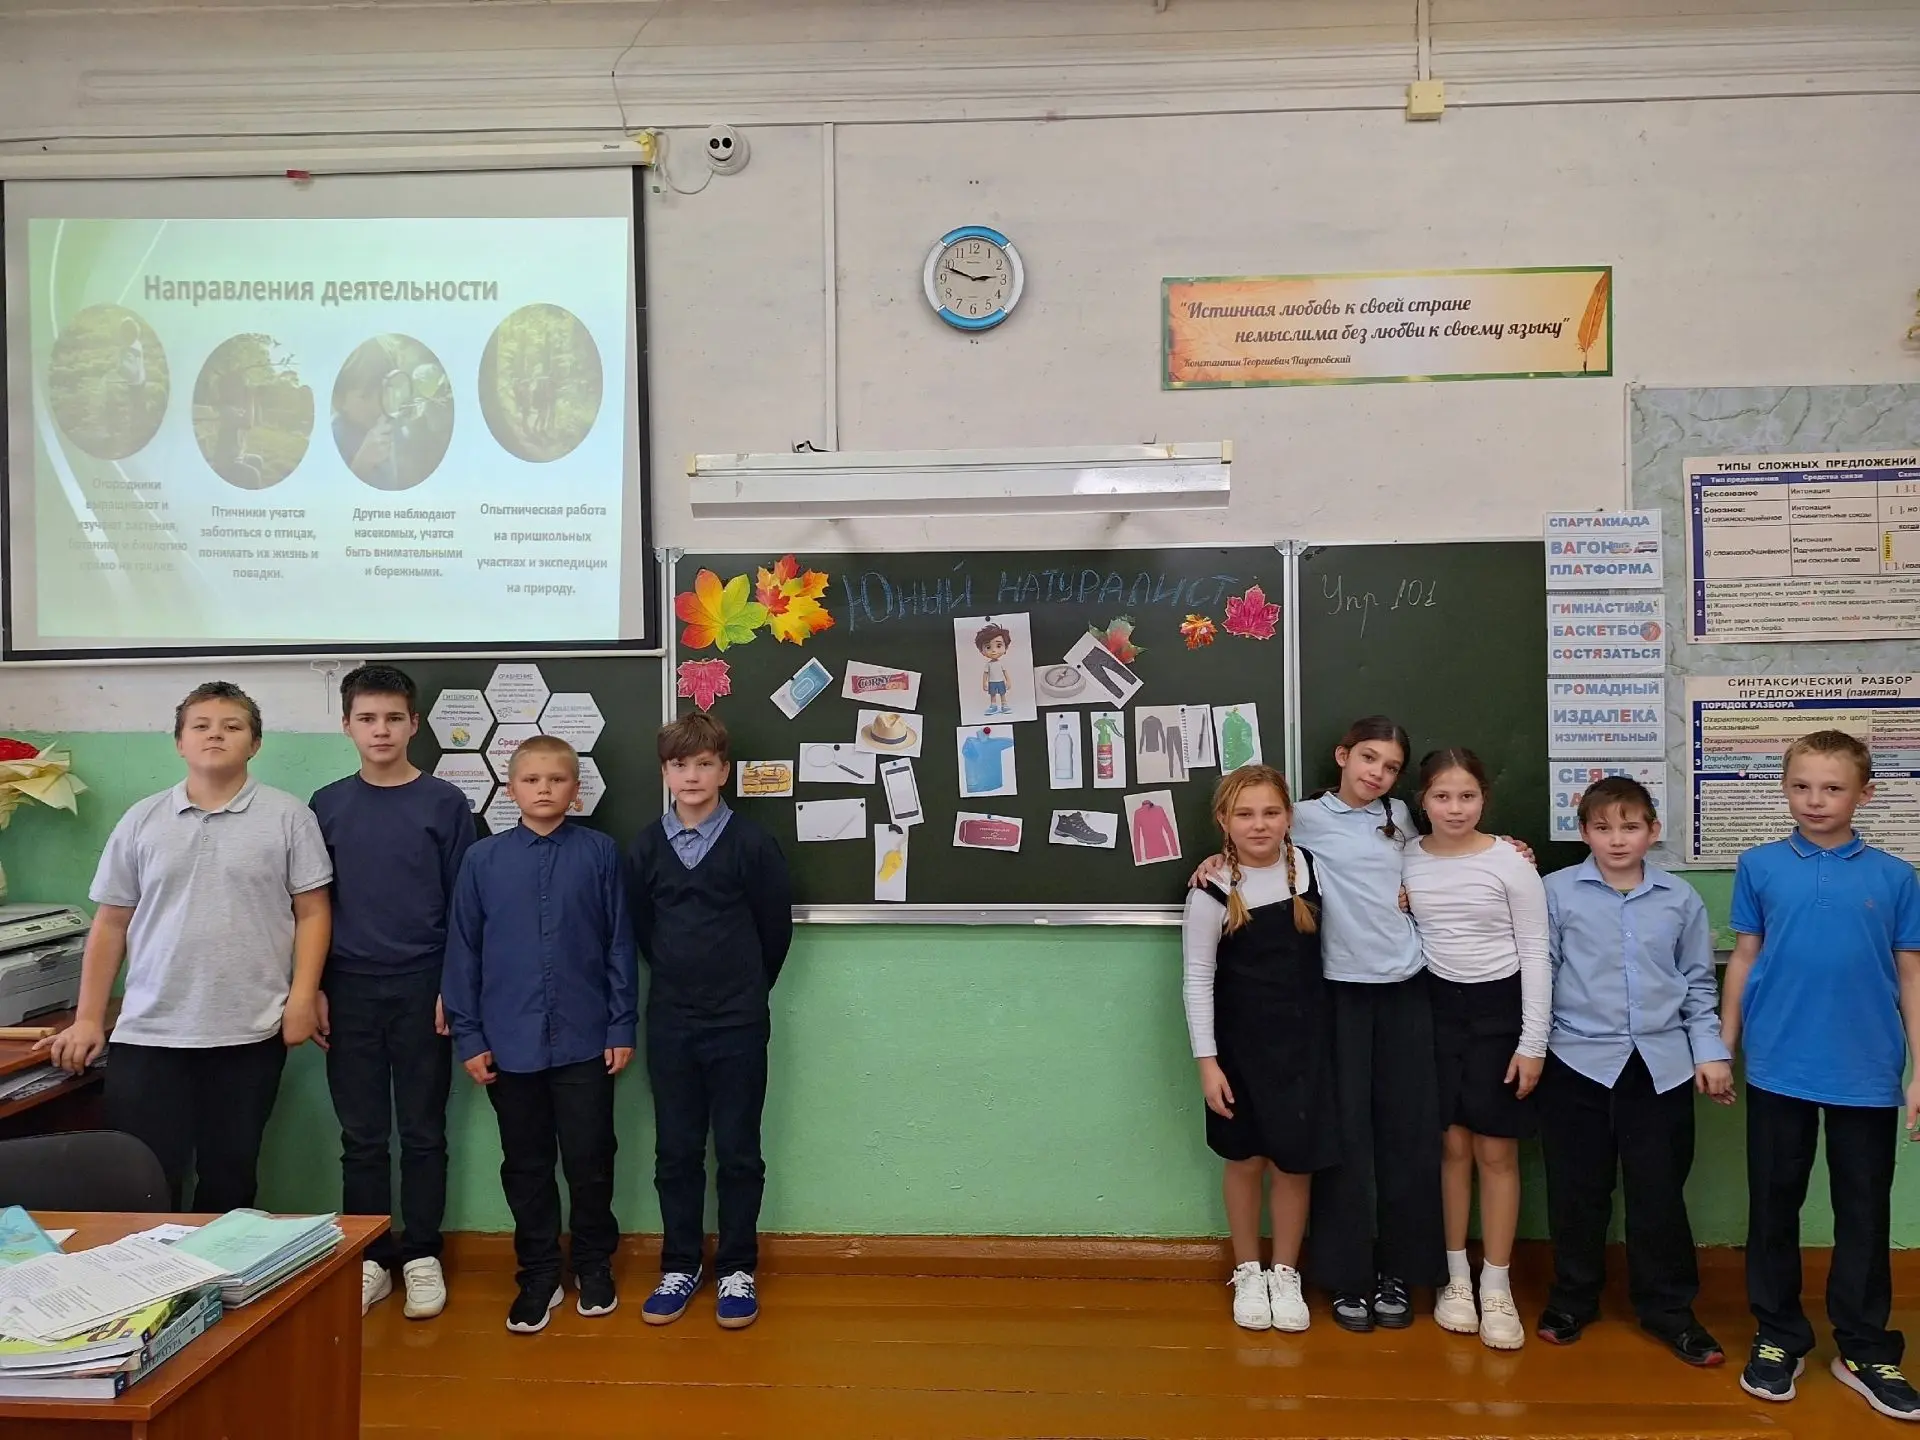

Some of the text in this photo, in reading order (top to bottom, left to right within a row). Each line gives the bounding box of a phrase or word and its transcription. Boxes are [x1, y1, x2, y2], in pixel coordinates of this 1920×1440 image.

[956, 248, 964, 258] 11
[969, 243, 981, 254] 12
[945, 259, 954, 269] 10
[996, 260, 1002, 270] 2
[940, 273, 947, 284] 9
[1001, 274, 1007, 285] 3
[144, 275, 499, 306] Направления деятельности
[945, 288, 952, 299] 8
[995, 289, 1001, 299] 4
[956, 298, 962, 309] 7
[970, 304, 976, 314] 6
[985, 300, 991, 310] 5
[1279, 299, 1340, 316] любовь
[1344, 303, 1355, 315] к
[1359, 297, 1404, 314] своей
[1408, 299, 1472, 316] стране
[1235, 327, 1337, 343] немыслима
[1341, 324, 1368, 344] без
[1371, 322, 1425, 339] любви
[1428, 325, 1440, 337] к
[1444, 320, 1504, 339] своему
[1184, 354, 1351, 368] Константин Георгиевич Паустовский
[1717, 456, 1916, 471] ТИПЫ СЛОЖНЫХ ПРЕДЛОЖЕНИЙ
[93, 478, 161, 491] Огородники
[161, 501, 169, 510] и
[480, 503, 607, 518] Опытническая работа
[212, 505, 305, 522] Птичники учатся
[352, 508, 456, 523] Другие наблюдают
[1549, 516, 1650, 528] СПАРТАКИАДА
[199, 526, 316, 542] заботиться о птицах,
[354, 528, 454, 542] насекомых, учатся
[494, 530, 591, 544] на пришкольных
[199, 548, 319, 559] понимать их жизнь и
[345, 546, 463, 559] быть внимательными
[477, 557, 608, 572] участках и экспедиции
[1550, 563, 1653, 575] ПЛАТФОРМА
[233, 567, 284, 580] повадки.
[365, 565, 443, 579] и бережными.
[507, 583, 576, 597] на природу.
[998, 568, 1240, 607] НАТУРАЛИСТ
[1322, 574, 1436, 638] Упр 101
[1552, 602, 1654, 614] ГИМНАСТИКА
[1553, 649, 1661, 659] СОСТЯЗАТЬСЯ
[1728, 676, 1912, 687] СИНТАКСИЧЕСКИЙ РАЗБОР
[1554, 682, 1659, 696] ГРОМАДНЫЙ
[1739, 687, 1901, 699] ПРЕДЛОЖЕНИЯ (памятка)
[1701, 701, 1794, 710] ПОРЯДОК РАЗБОРА
[1553, 708, 1657, 725] ИЗДАЛЕКА
[1783, 715, 1834, 723] предложение
[1555, 732, 1657, 742] ИЗУМИТЕЛЬНЫЙ
[1559, 768, 1633, 783] СЕЯТЬ
